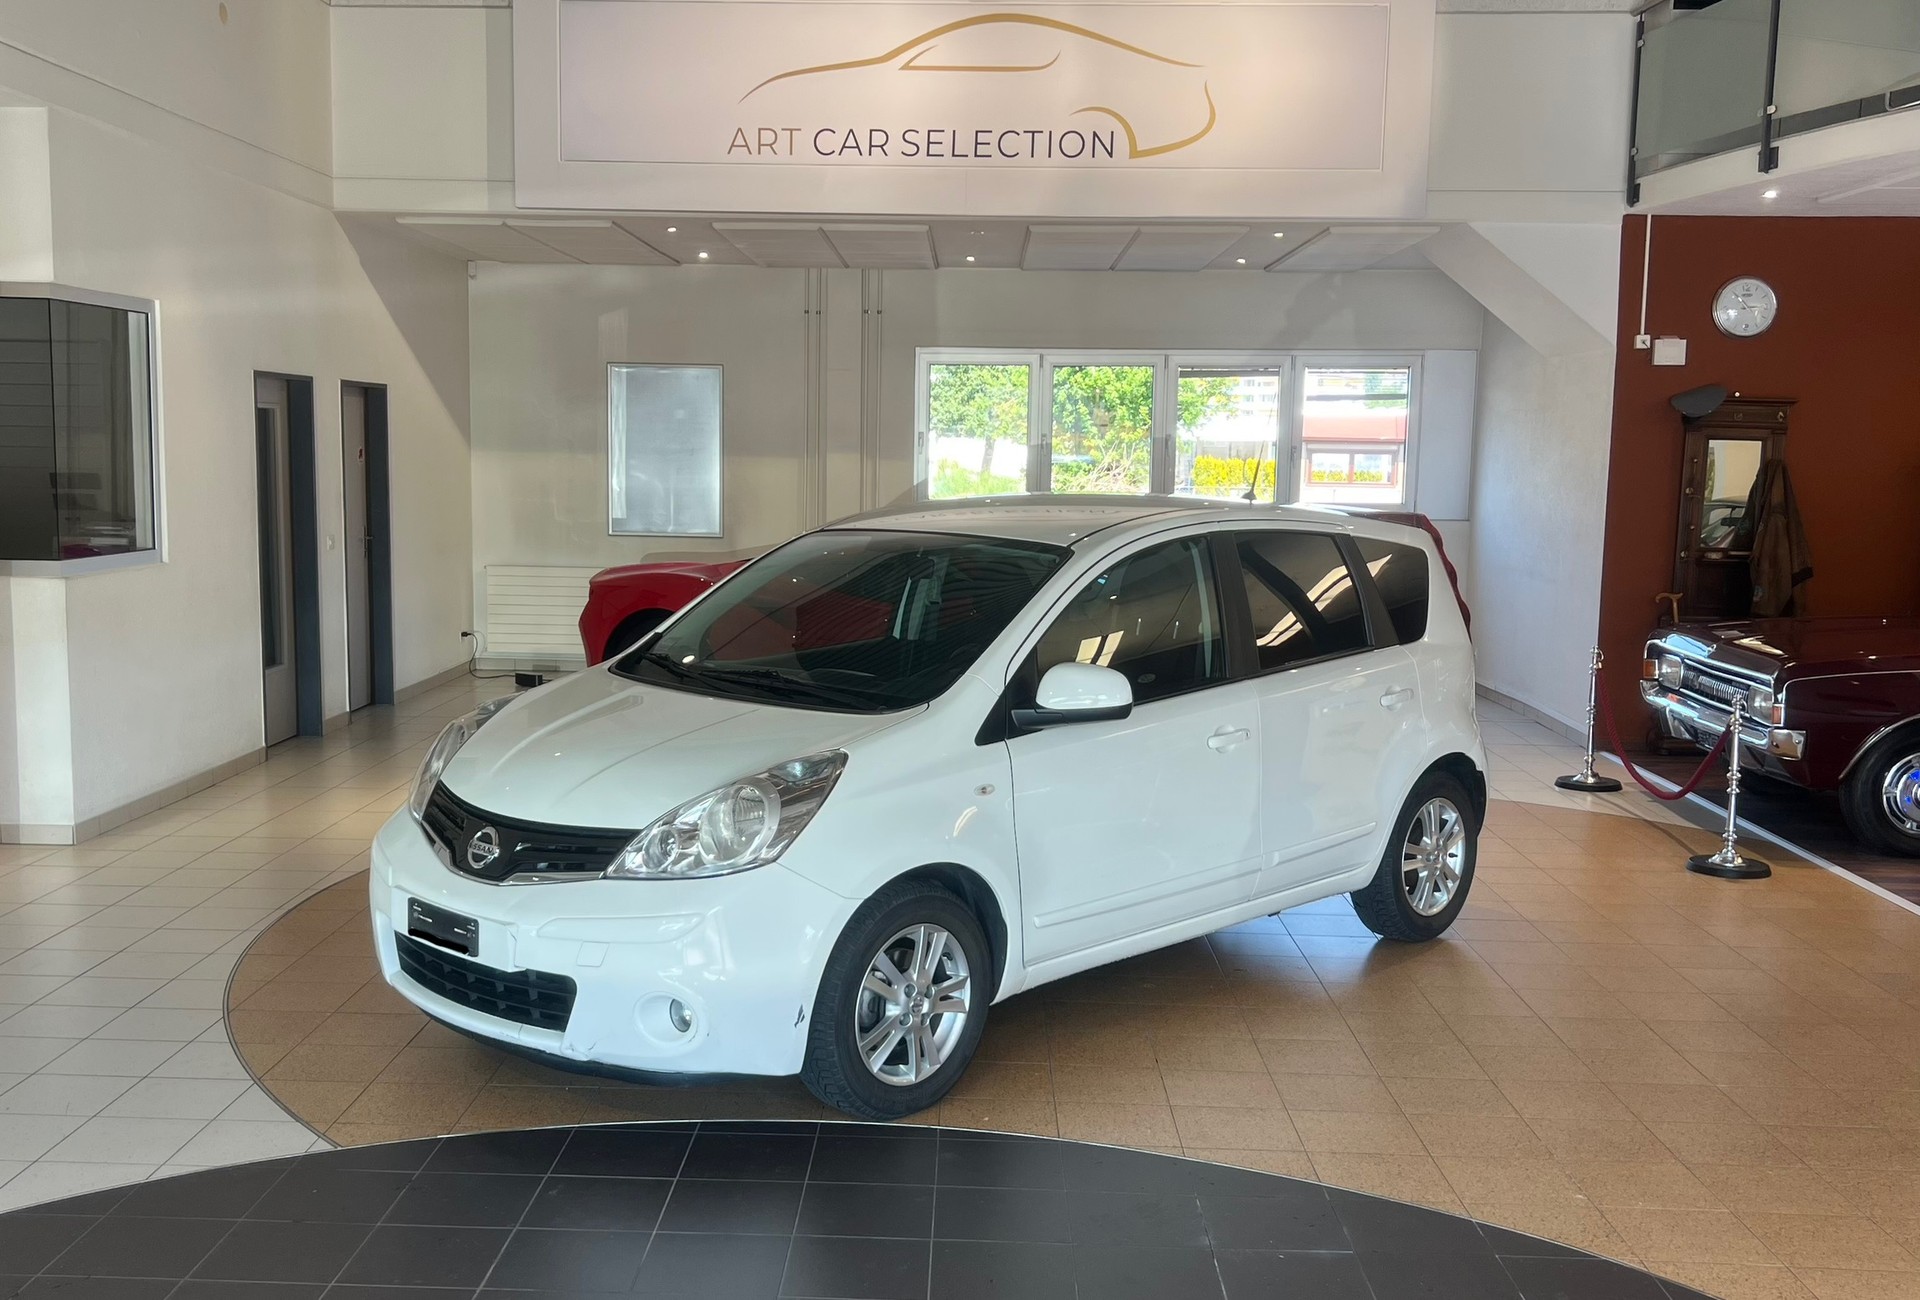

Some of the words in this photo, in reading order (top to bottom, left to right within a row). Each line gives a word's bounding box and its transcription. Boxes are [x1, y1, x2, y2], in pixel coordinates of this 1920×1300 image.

[727, 127, 802, 156] ART
[813, 128, 888, 157] CAR
[901, 129, 1115, 159] SELECTION
[469, 842, 494, 854] SSAN
